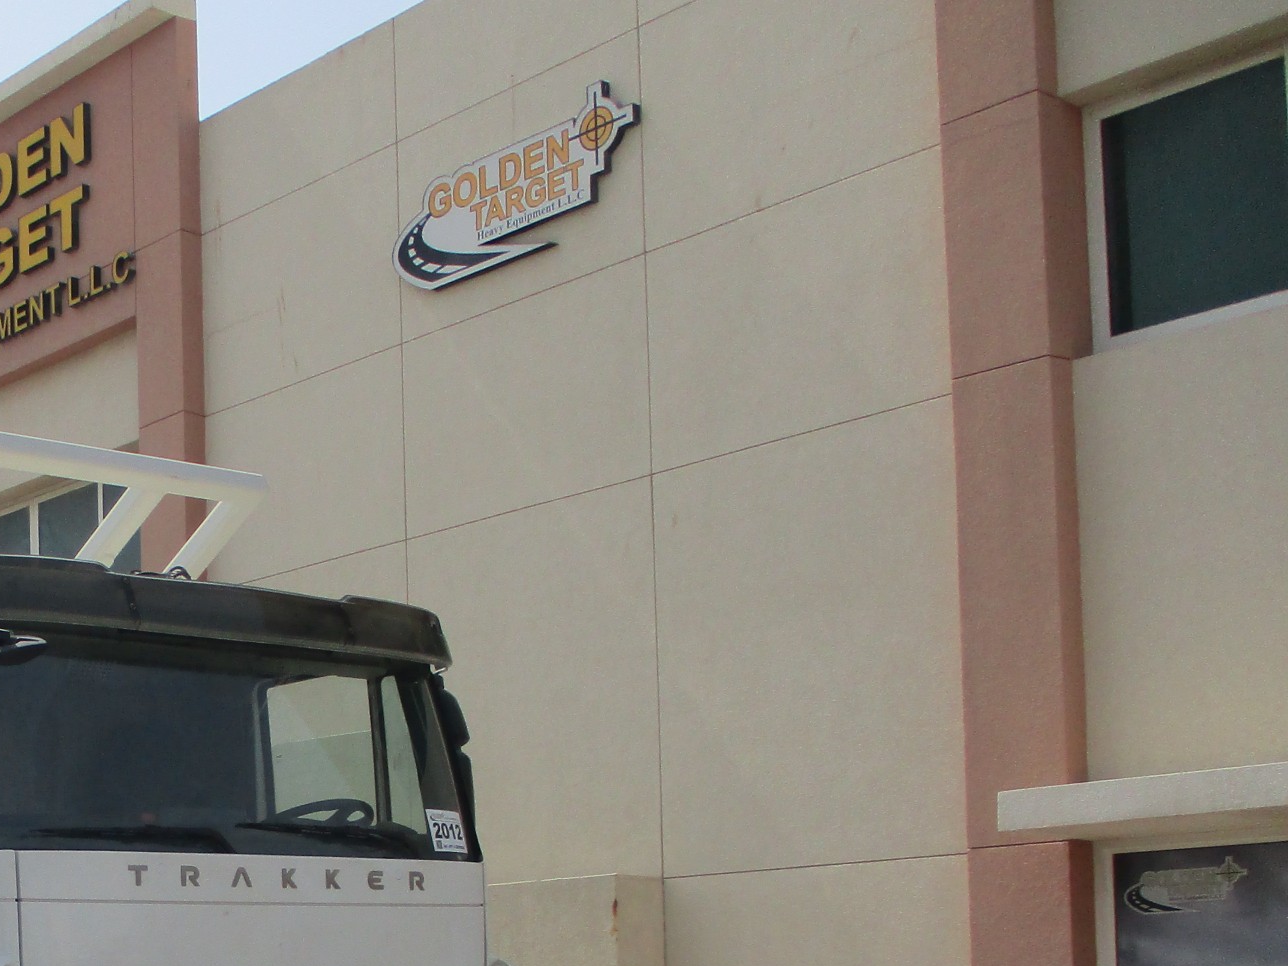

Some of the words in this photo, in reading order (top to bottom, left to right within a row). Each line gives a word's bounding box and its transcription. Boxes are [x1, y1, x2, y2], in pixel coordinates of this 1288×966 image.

[428, 128, 570, 218] GOLDEN
[469, 158, 584, 231] TARGET
[477, 223, 505, 241] Heavy
[506, 203, 555, 229] Equipment
[67, 251, 137, 308] L.L.C
[433, 822, 463, 841] 2012
[128, 864, 426, 892] TRAKKER
